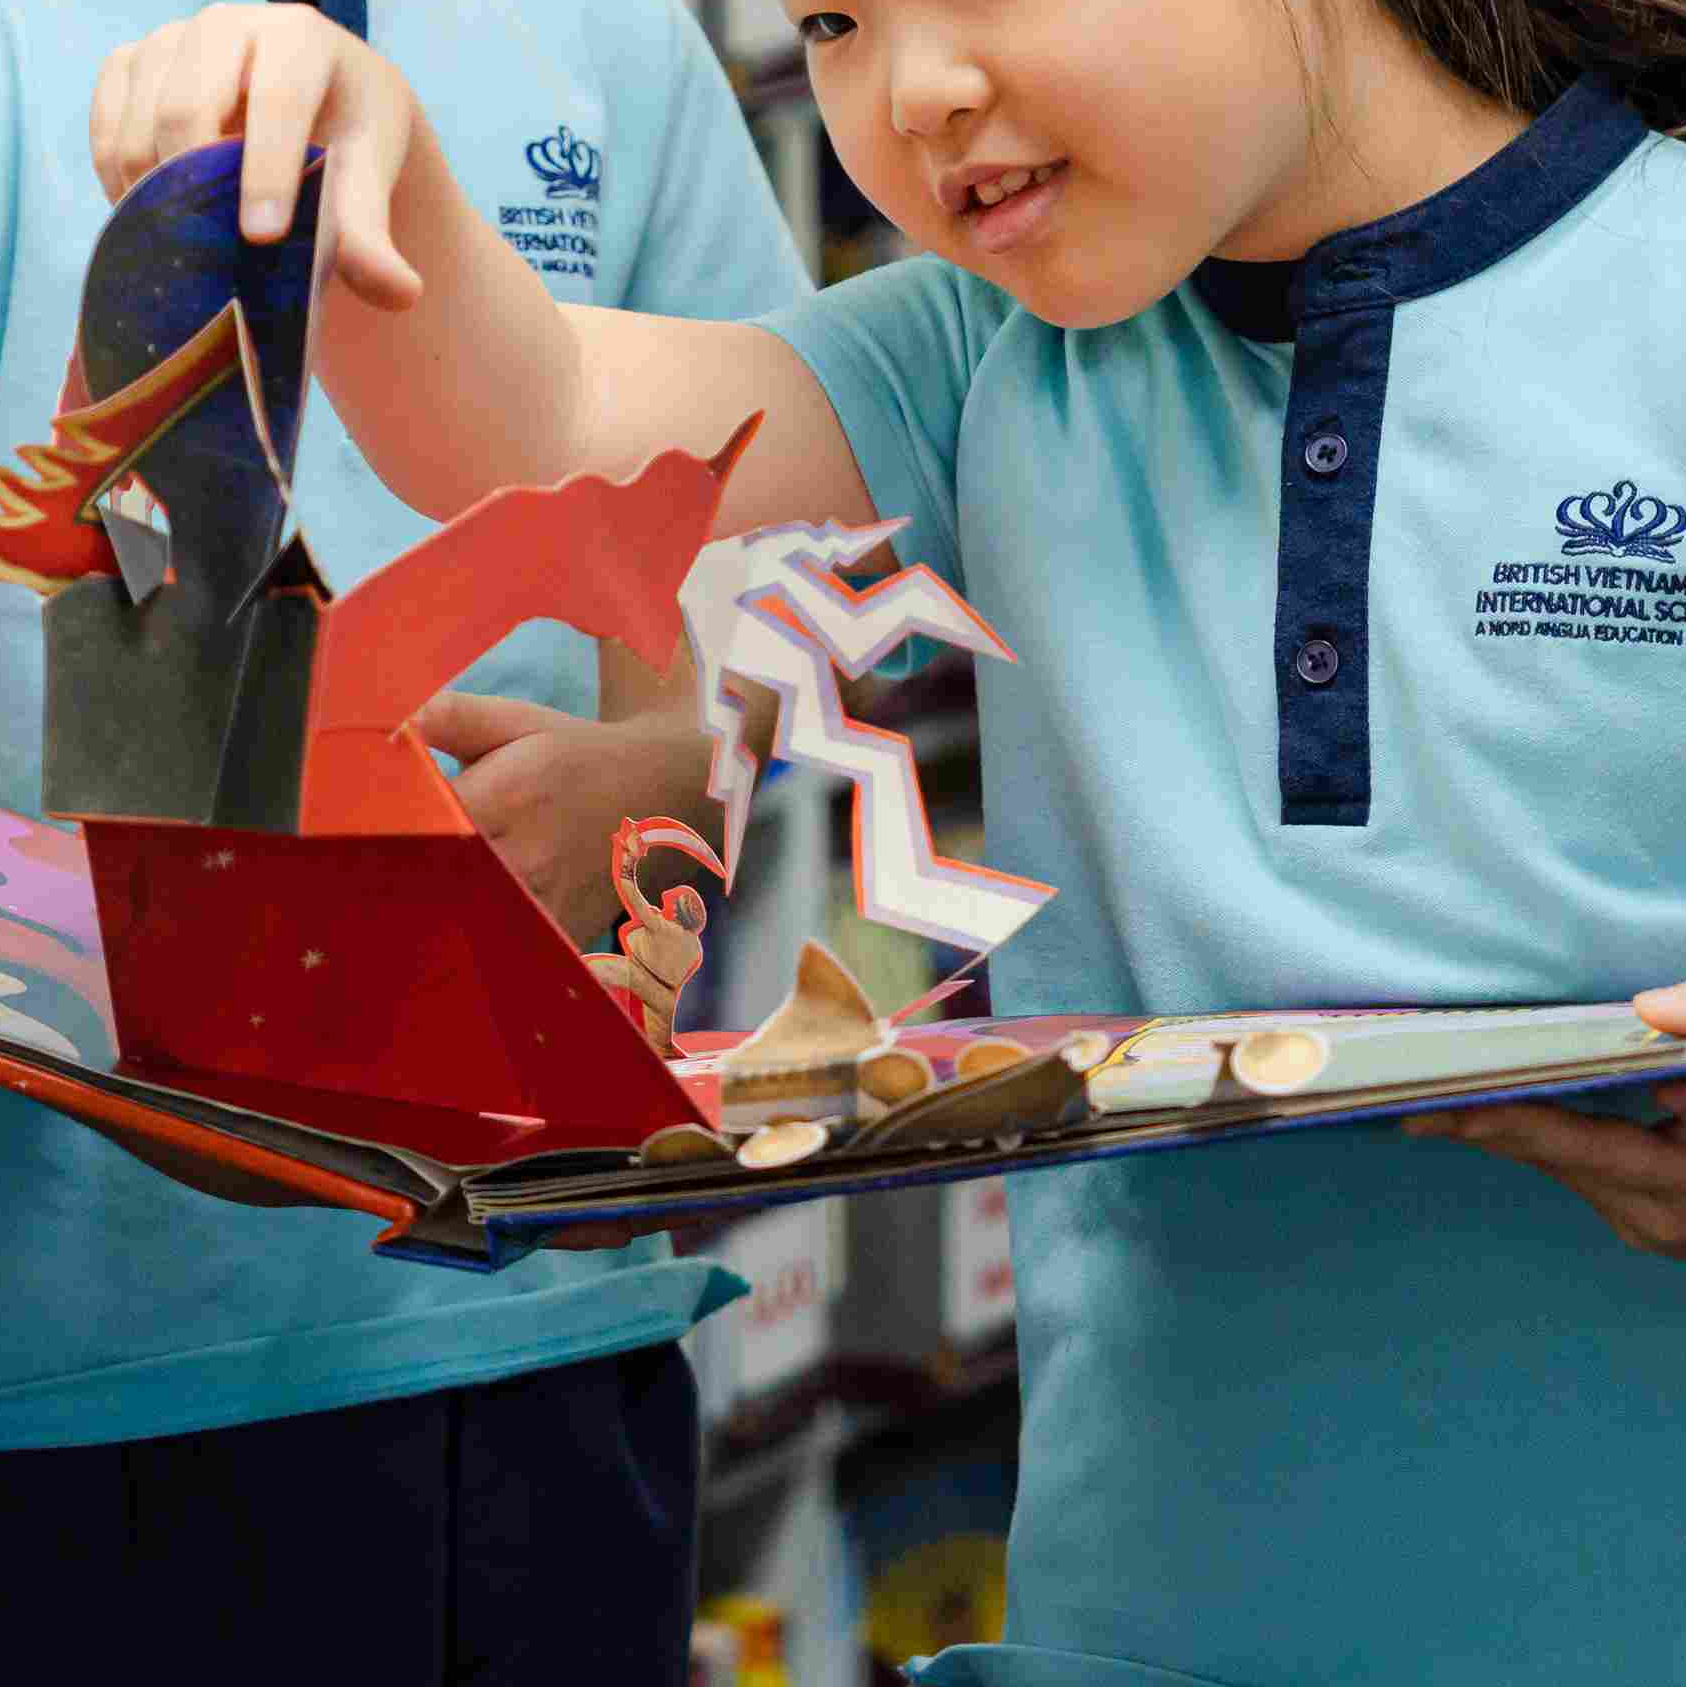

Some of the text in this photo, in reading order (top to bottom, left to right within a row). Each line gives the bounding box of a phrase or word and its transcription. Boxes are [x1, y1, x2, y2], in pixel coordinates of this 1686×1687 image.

[499, 205, 564, 226] BRITISH
[1493, 562, 1580, 586] BRITISH
[1475, 590, 1651, 622] INTERNATIONAL
[1475, 621, 1486, 636] A
[1489, 620, 1530, 637] NORD
[1534, 621, 1591, 641] ANGLIA
[1594, 623, 1683, 647] EDUCATION
